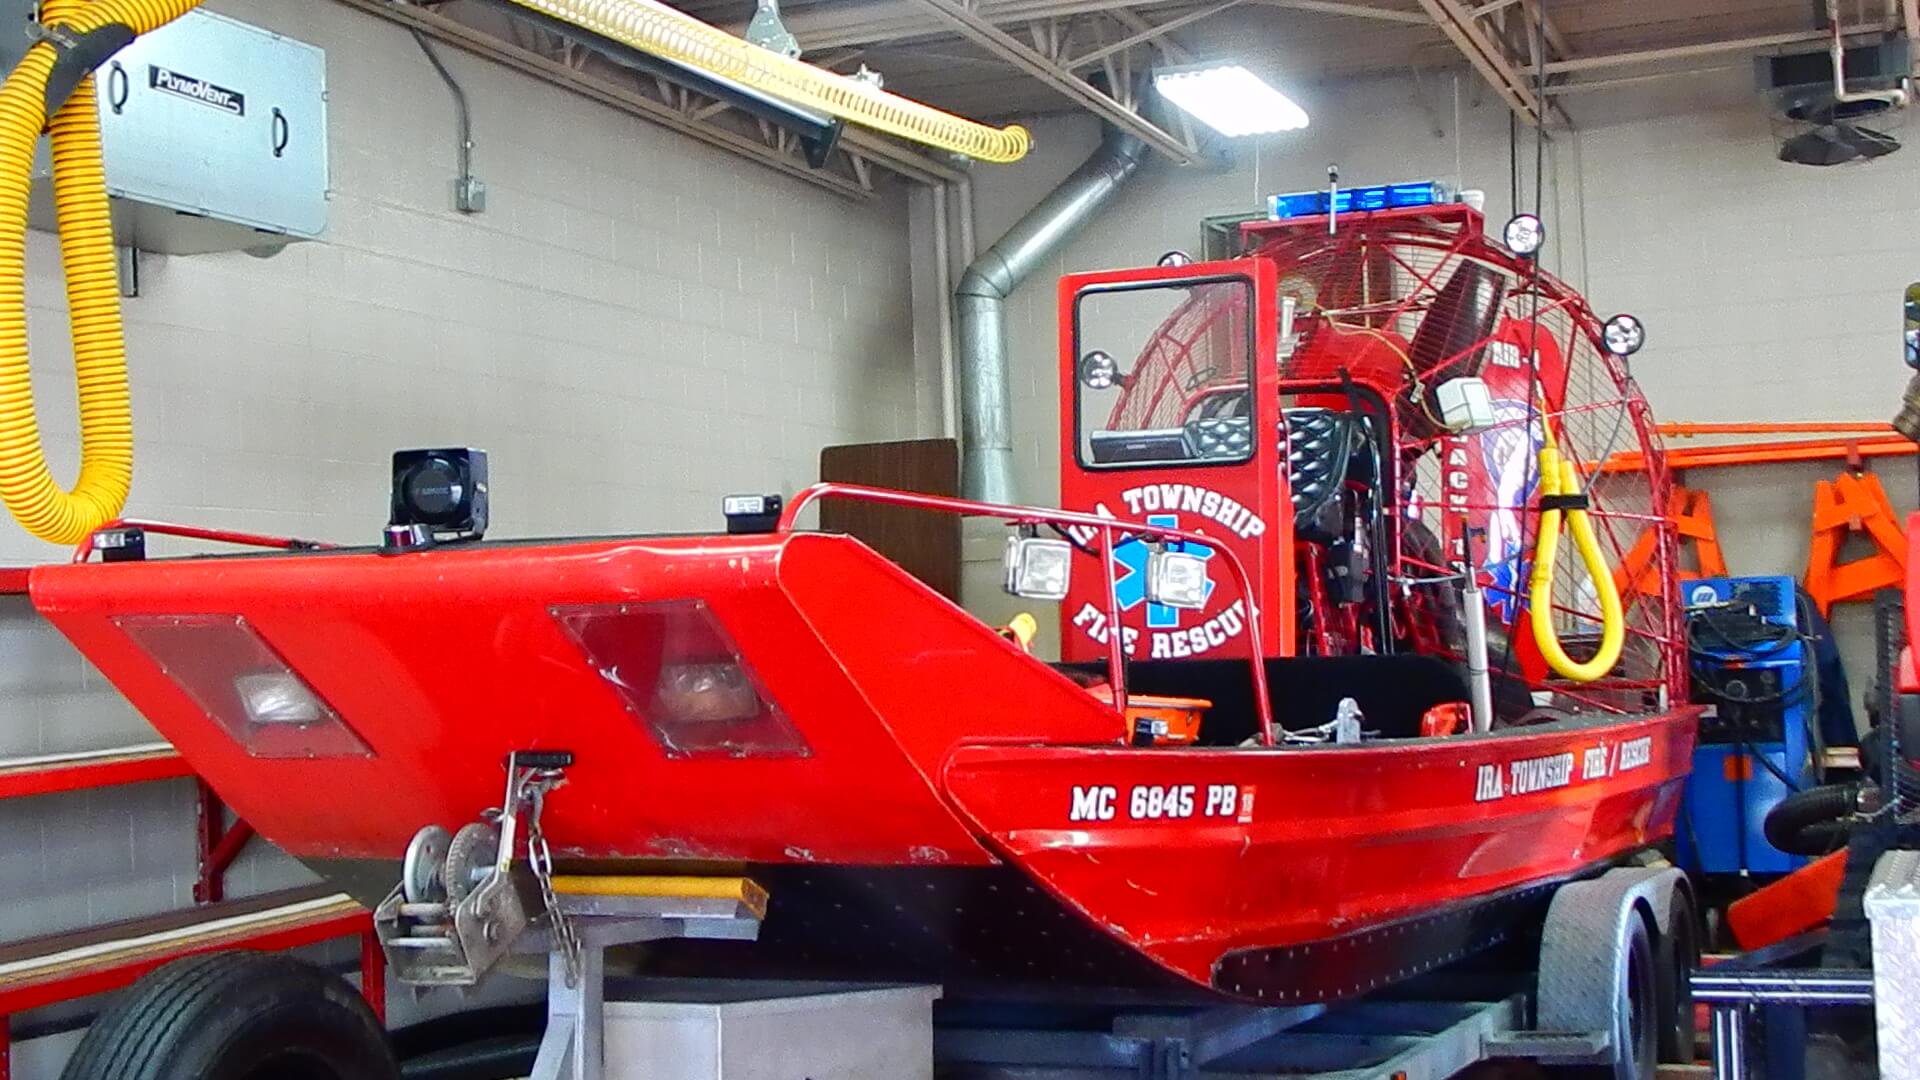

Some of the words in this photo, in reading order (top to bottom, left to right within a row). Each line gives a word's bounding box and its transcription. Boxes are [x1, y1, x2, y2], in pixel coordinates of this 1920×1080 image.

[1122, 484, 1266, 540] TOWNSHIP
[1475, 764, 1504, 801] IRA
[1510, 752, 1574, 795] TOWNSHIP
[1070, 786, 1117, 821] MC
[1130, 785, 1196, 819] 6845
[1205, 785, 1237, 816] PB
